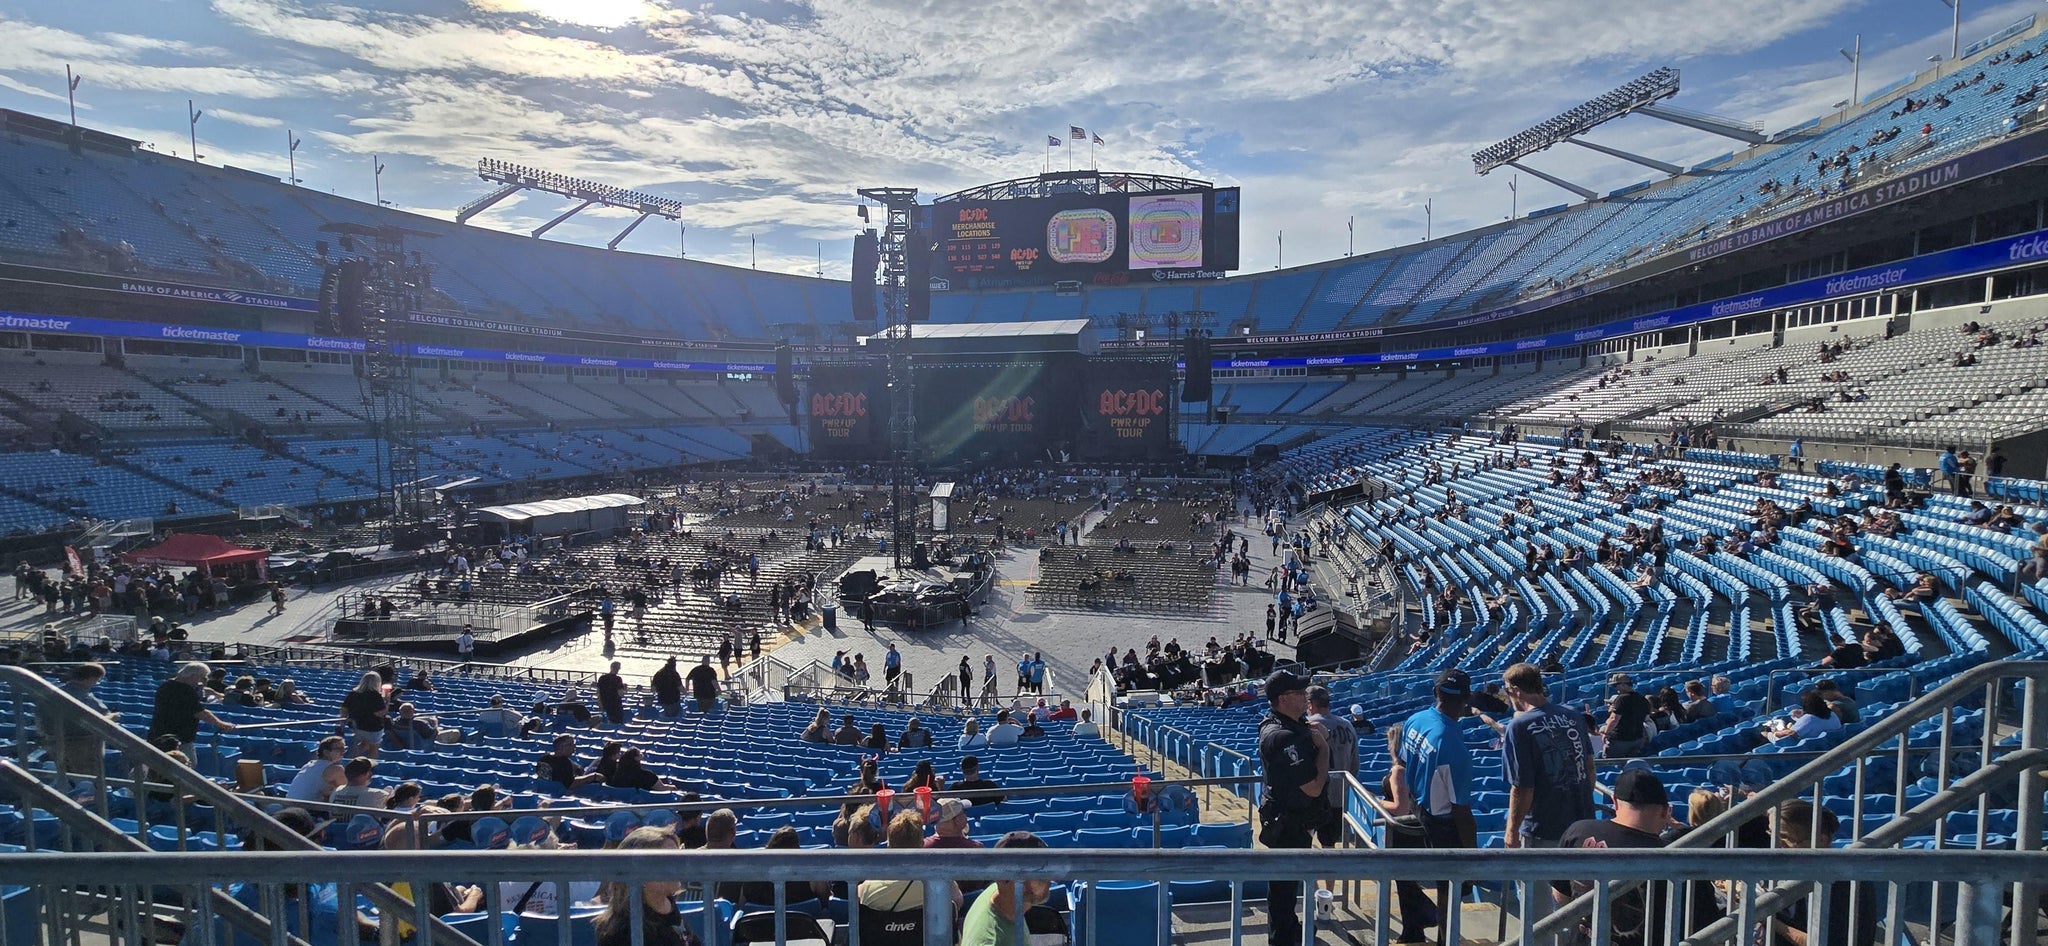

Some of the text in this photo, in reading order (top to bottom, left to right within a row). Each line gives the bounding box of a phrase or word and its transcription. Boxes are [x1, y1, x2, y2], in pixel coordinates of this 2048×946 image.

[1689, 163, 1960, 260] WELCOME TO BANK OF AMERICA STADIUM
[952, 222, 996, 230] MERCHANDISE
[957, 230, 990, 238] LOCATIONS
[1167, 270, 1225, 279] Harris Teeter
[1826, 266, 1907, 295] ticketmaster
[122, 283, 288, 307] BANK OF AMERICA STADIUM
[1711, 296, 1764, 315] ticketmaster
[0, 315, 71, 330] etmaster
[409, 313, 562, 337] WELCOME TO BANK OF AMERICA STADIUM
[1633, 315, 1671, 330] ticketmaster
[162, 326, 241, 341] ticketmaster
[1320, 332, 1351, 340] AMERICA
[1352, 329, 1383, 338] STADIUM
[1574, 328, 1605, 341] ticketmaster
[1516, 339, 1547, 349] ticketmaster
[418, 346, 464, 357] ticketmaster
[1454, 346, 1488, 356] ticketmaster
[505, 352, 546, 362] ticketmaster
[581, 357, 618, 366] ticketmaster
[1306, 357, 1344, 365] ticketmaster
[1380, 352, 1419, 361] ticketmaster
[653, 361, 691, 370] ticketmaster
[727, 364, 765, 372] ticketmaster
[1231, 360, 1269, 368] ticketmaster
[812, 392, 867, 417] AC/DC
[1099, 389, 1164, 415] AC/DC
[1009, 423, 1033, 432] TOUR
[827, 428, 850, 438] TOUR
[1116, 428, 1143, 438] TOUR
[885, 921, 915, 931] drive
